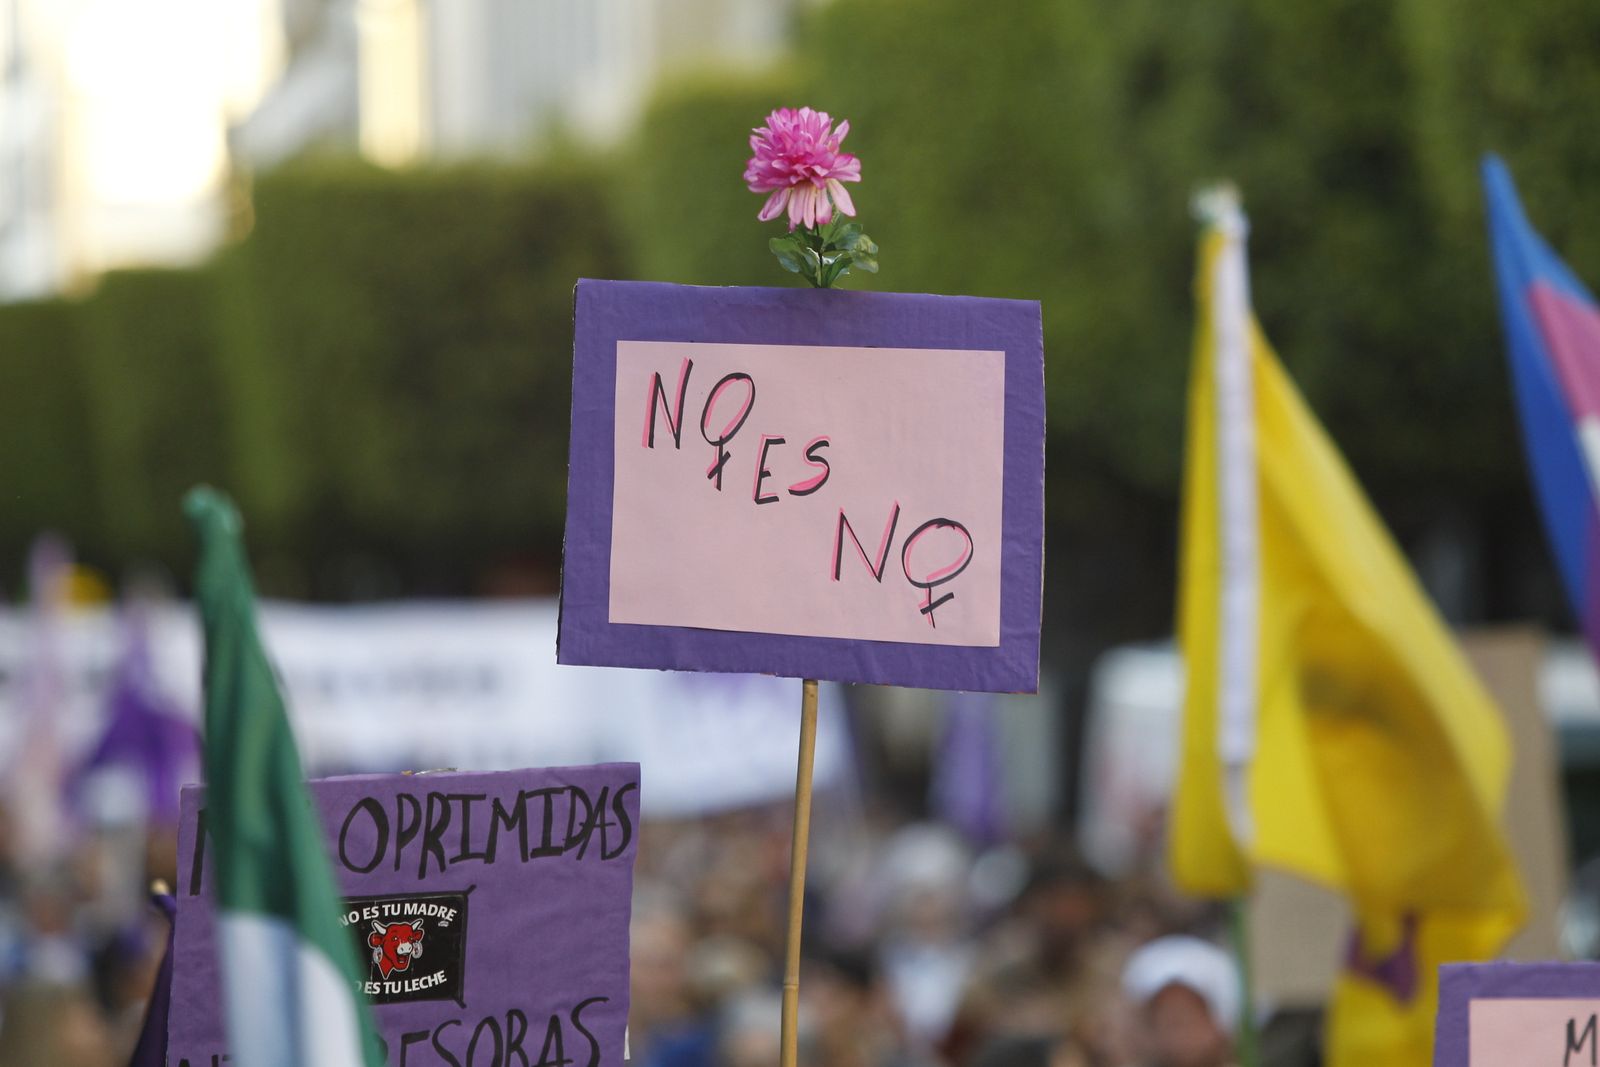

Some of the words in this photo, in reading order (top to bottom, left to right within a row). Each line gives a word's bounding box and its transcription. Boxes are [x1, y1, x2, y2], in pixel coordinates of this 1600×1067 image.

[642, 357, 756, 491] NO
[753, 433, 831, 505] ES
[830, 500, 974, 629] NO
[338, 782, 638, 880] OPRIMIDAS
[339, 911, 360, 927] NO
[363, 905, 380, 920] ES
[382, 903, 401, 917] TU
[403, 902, 458, 922] MADRE
[364, 981, 380, 994] ES
[383, 981, 402, 994] TU
[404, 970, 448, 992] LECHE
